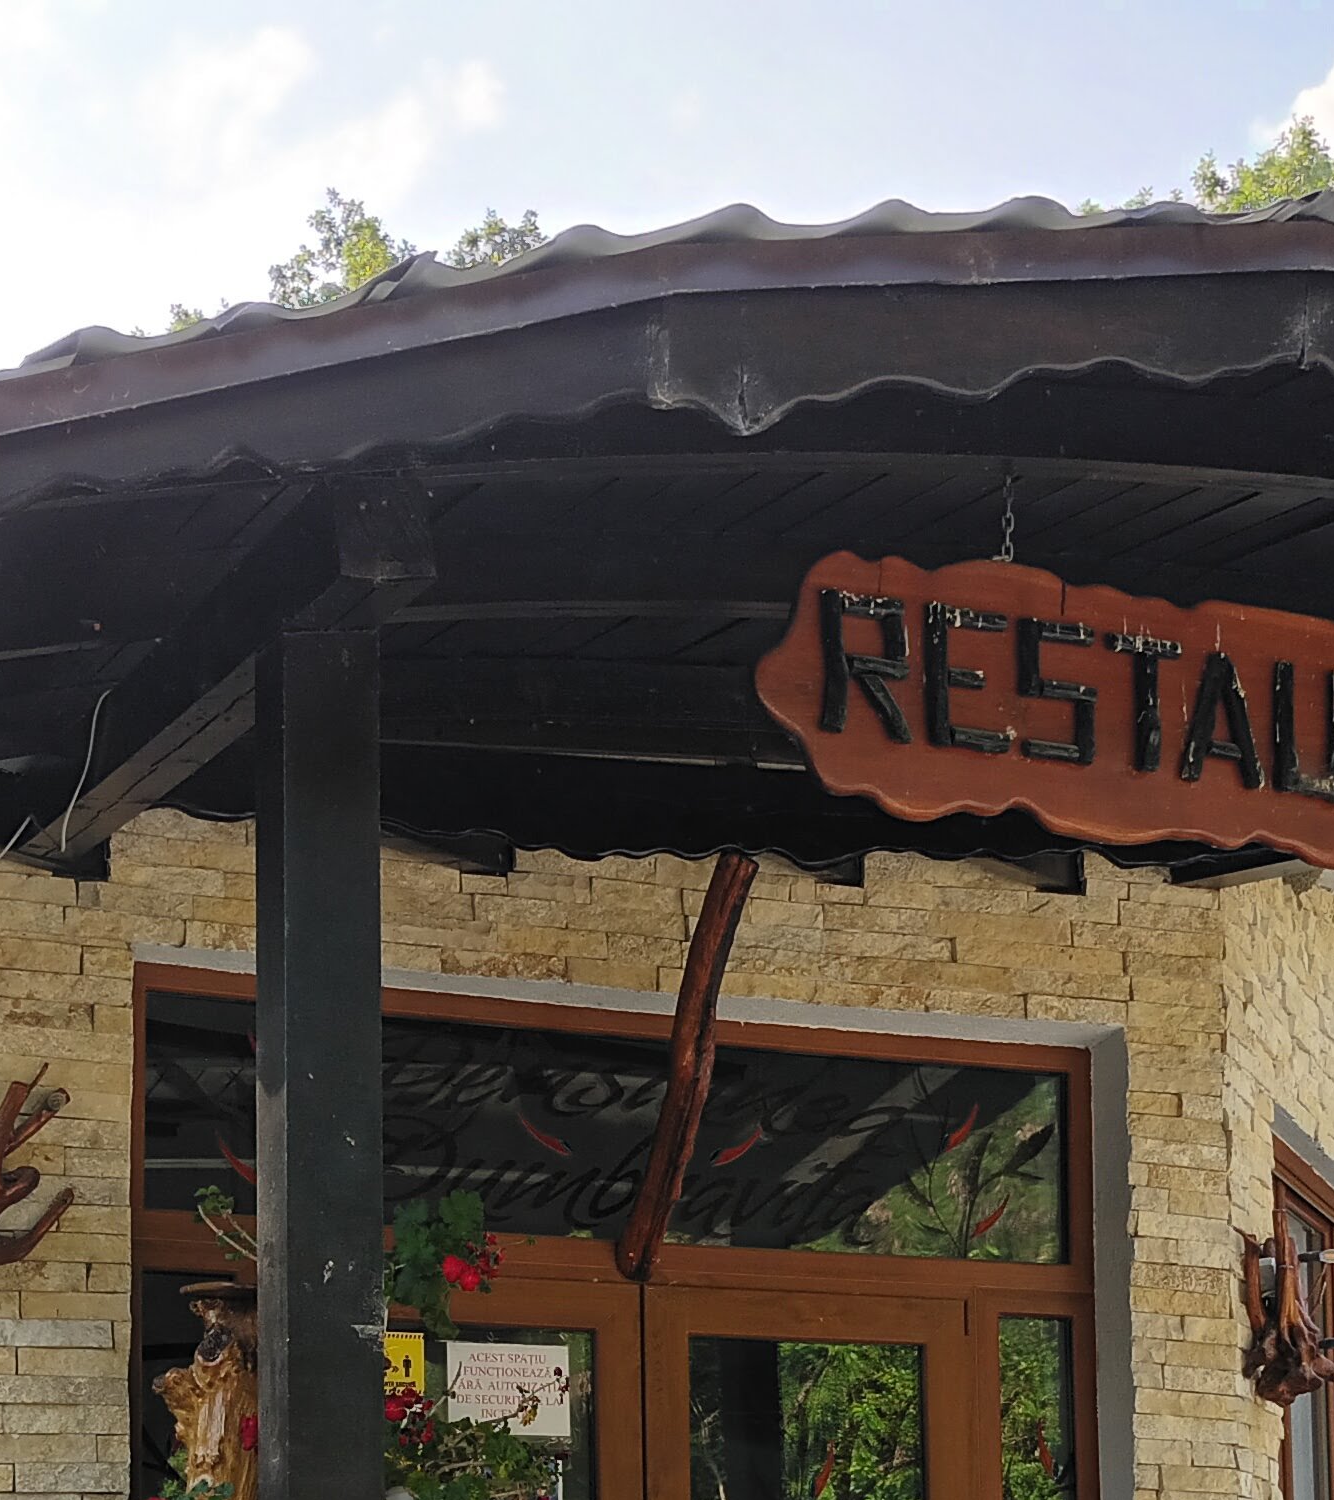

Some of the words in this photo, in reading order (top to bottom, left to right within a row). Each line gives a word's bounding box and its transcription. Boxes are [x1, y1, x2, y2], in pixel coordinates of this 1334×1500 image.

[467, 1352, 505, 1362] ACEST
[456, 1394, 472, 1404] DE
[546, 1396, 561, 1407] LA
